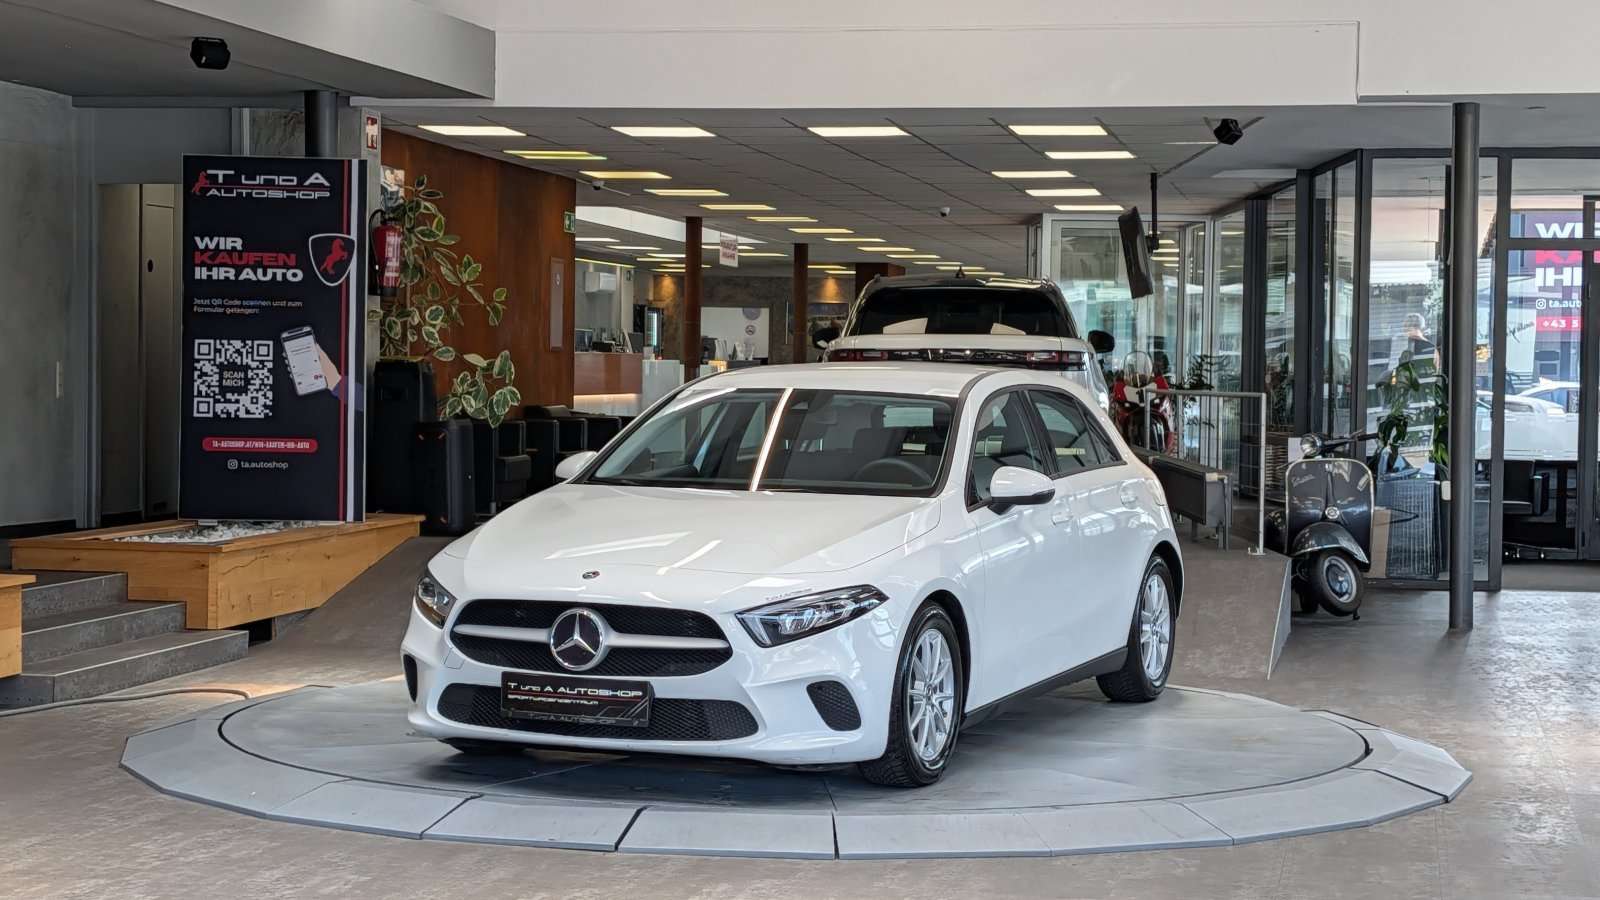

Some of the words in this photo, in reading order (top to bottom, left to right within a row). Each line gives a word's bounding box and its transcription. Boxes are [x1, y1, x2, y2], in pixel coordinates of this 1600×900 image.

[207, 169, 235, 184] T
[303, 172, 331, 187] A
[206, 188, 330, 199] AUTOSHOP
[193, 236, 243, 250] WIR
[194, 251, 297, 266] KAUFEN
[194, 266, 236, 280] IHR
[238, 267, 304, 282] AUTO
[211, 298, 223, 306] QR
[223, 298, 241, 306] Code
[272, 299, 286, 307] und
[222, 370, 245, 379] SCAN
[222, 379, 245, 387] MICH
[240, 460, 289, 470] ta.autoshop
[556, 686, 643, 697] AUTOSHOP
